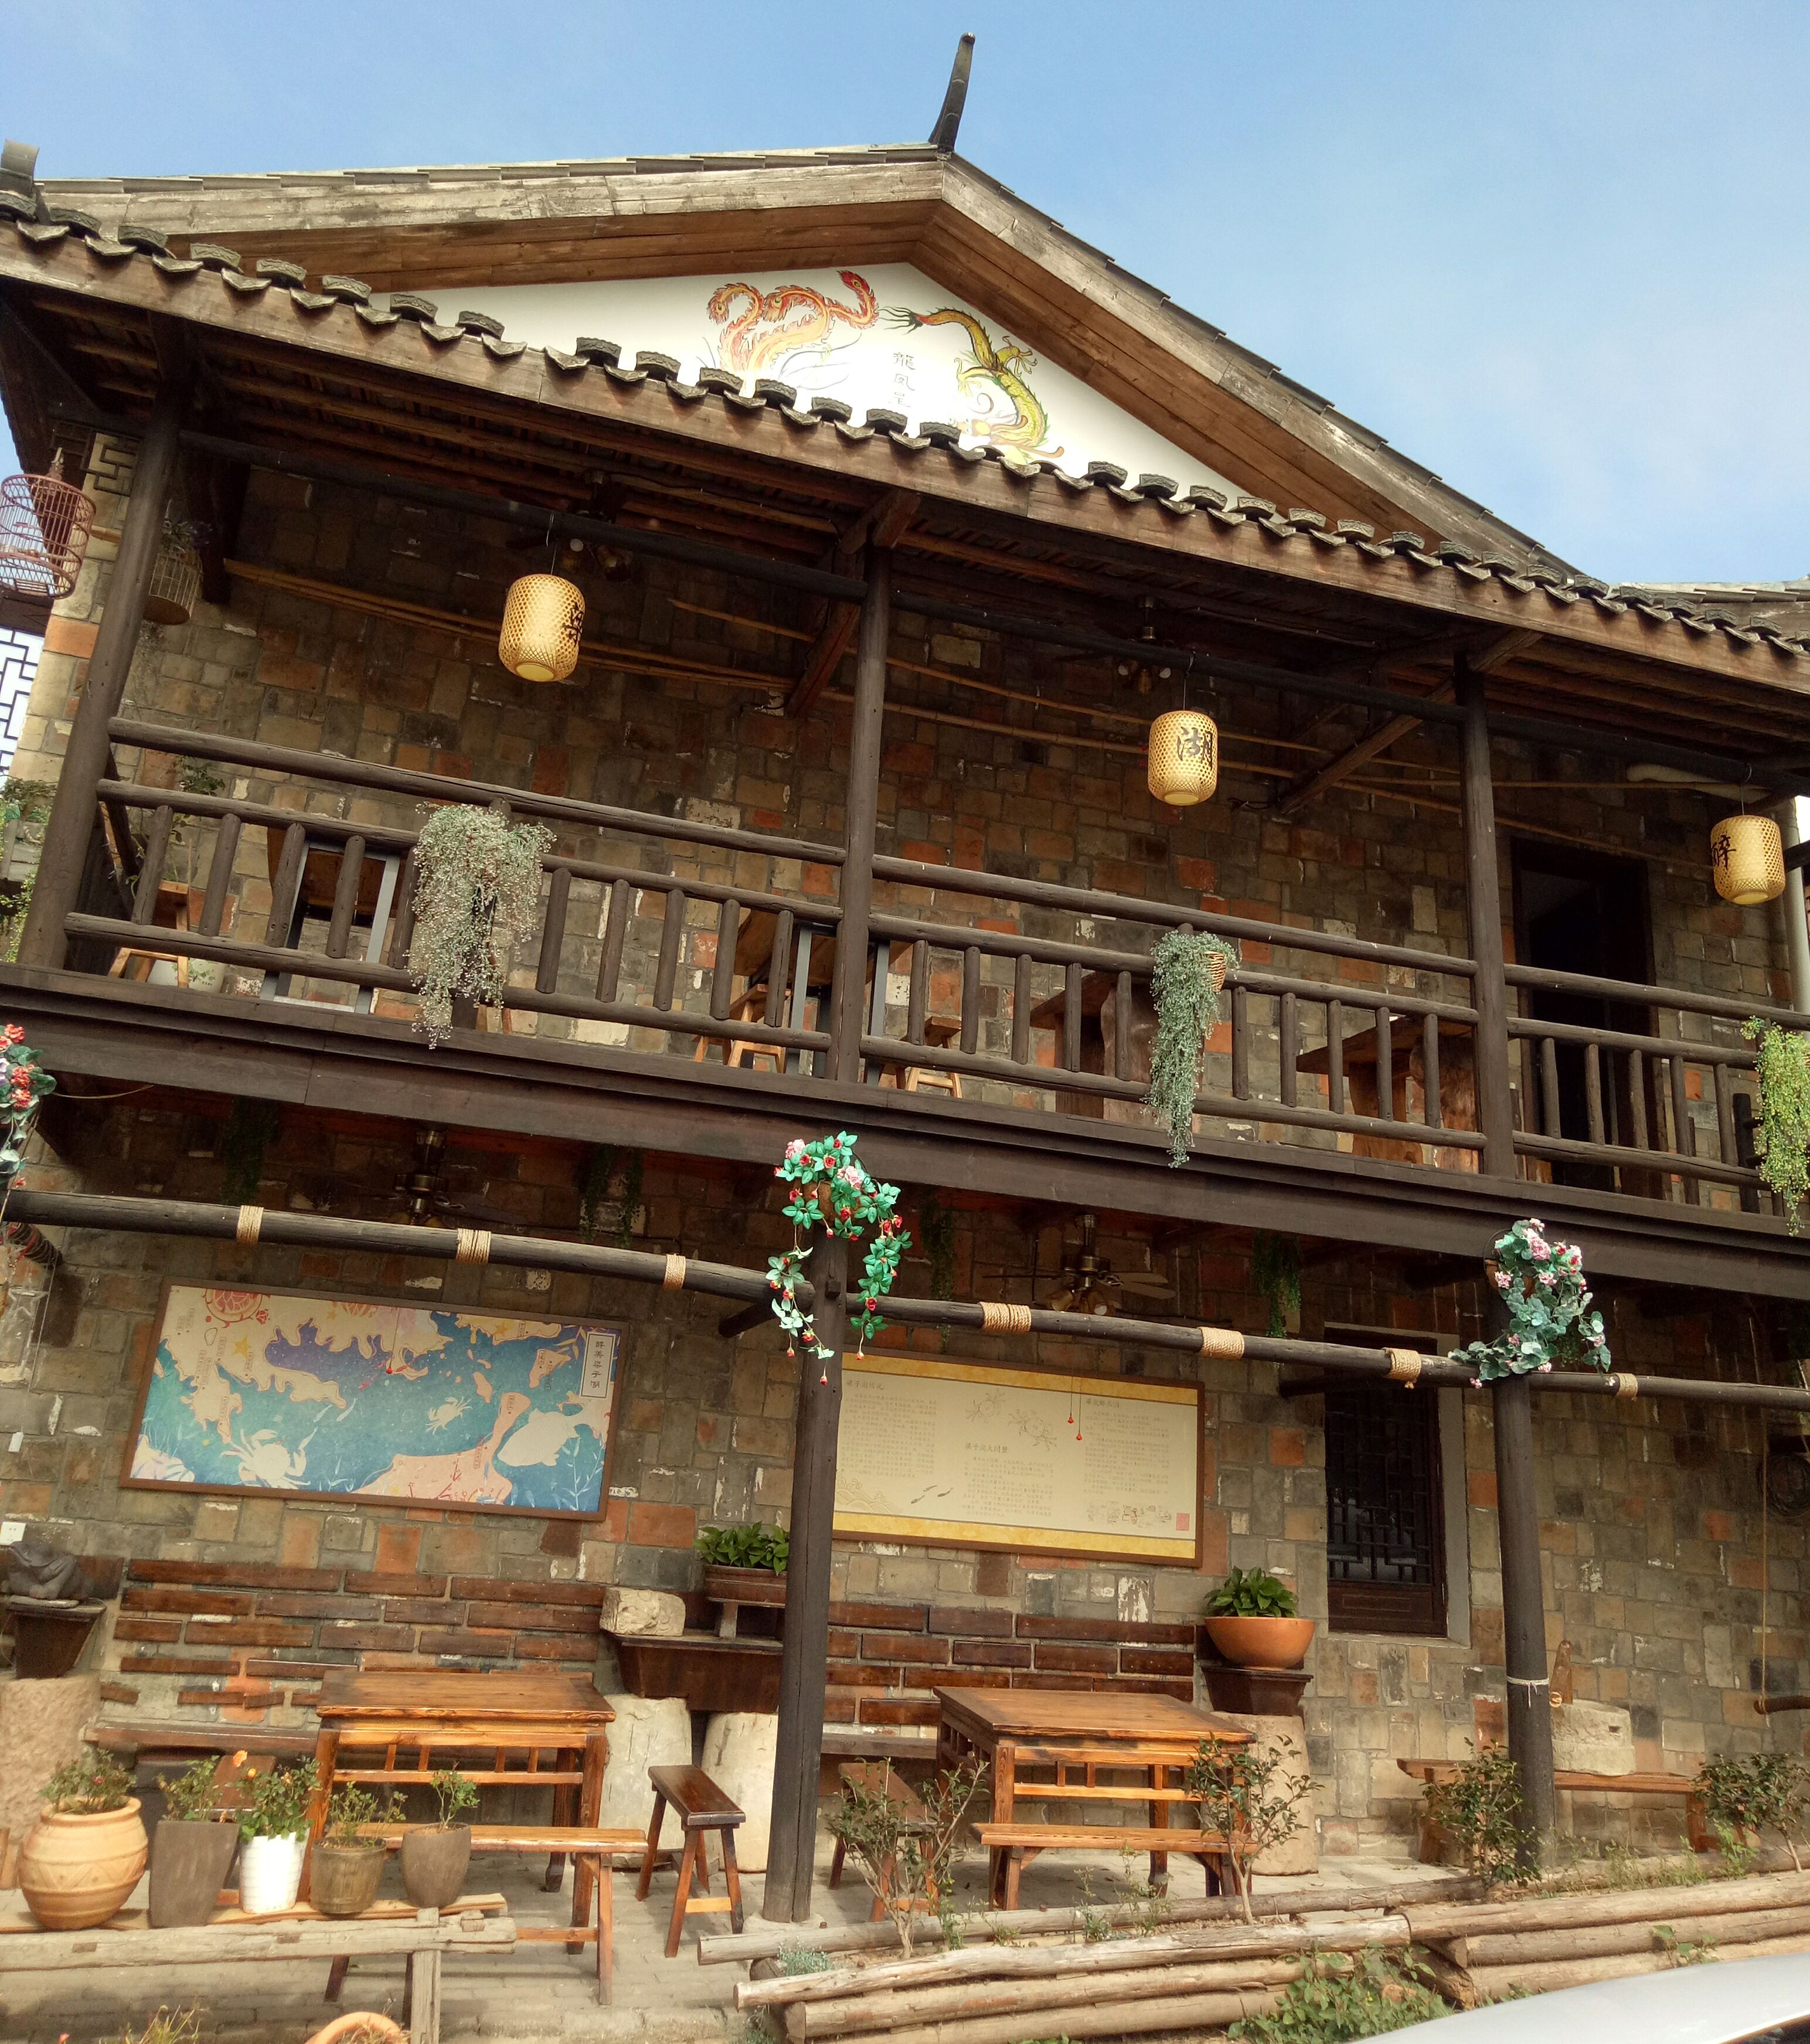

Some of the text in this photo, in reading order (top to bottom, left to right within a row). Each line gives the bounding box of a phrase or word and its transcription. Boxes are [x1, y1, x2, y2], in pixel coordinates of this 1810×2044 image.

[1176, 726, 1213, 771] 湖
[590, 1341, 605, 1388] 醉美梁子湖
